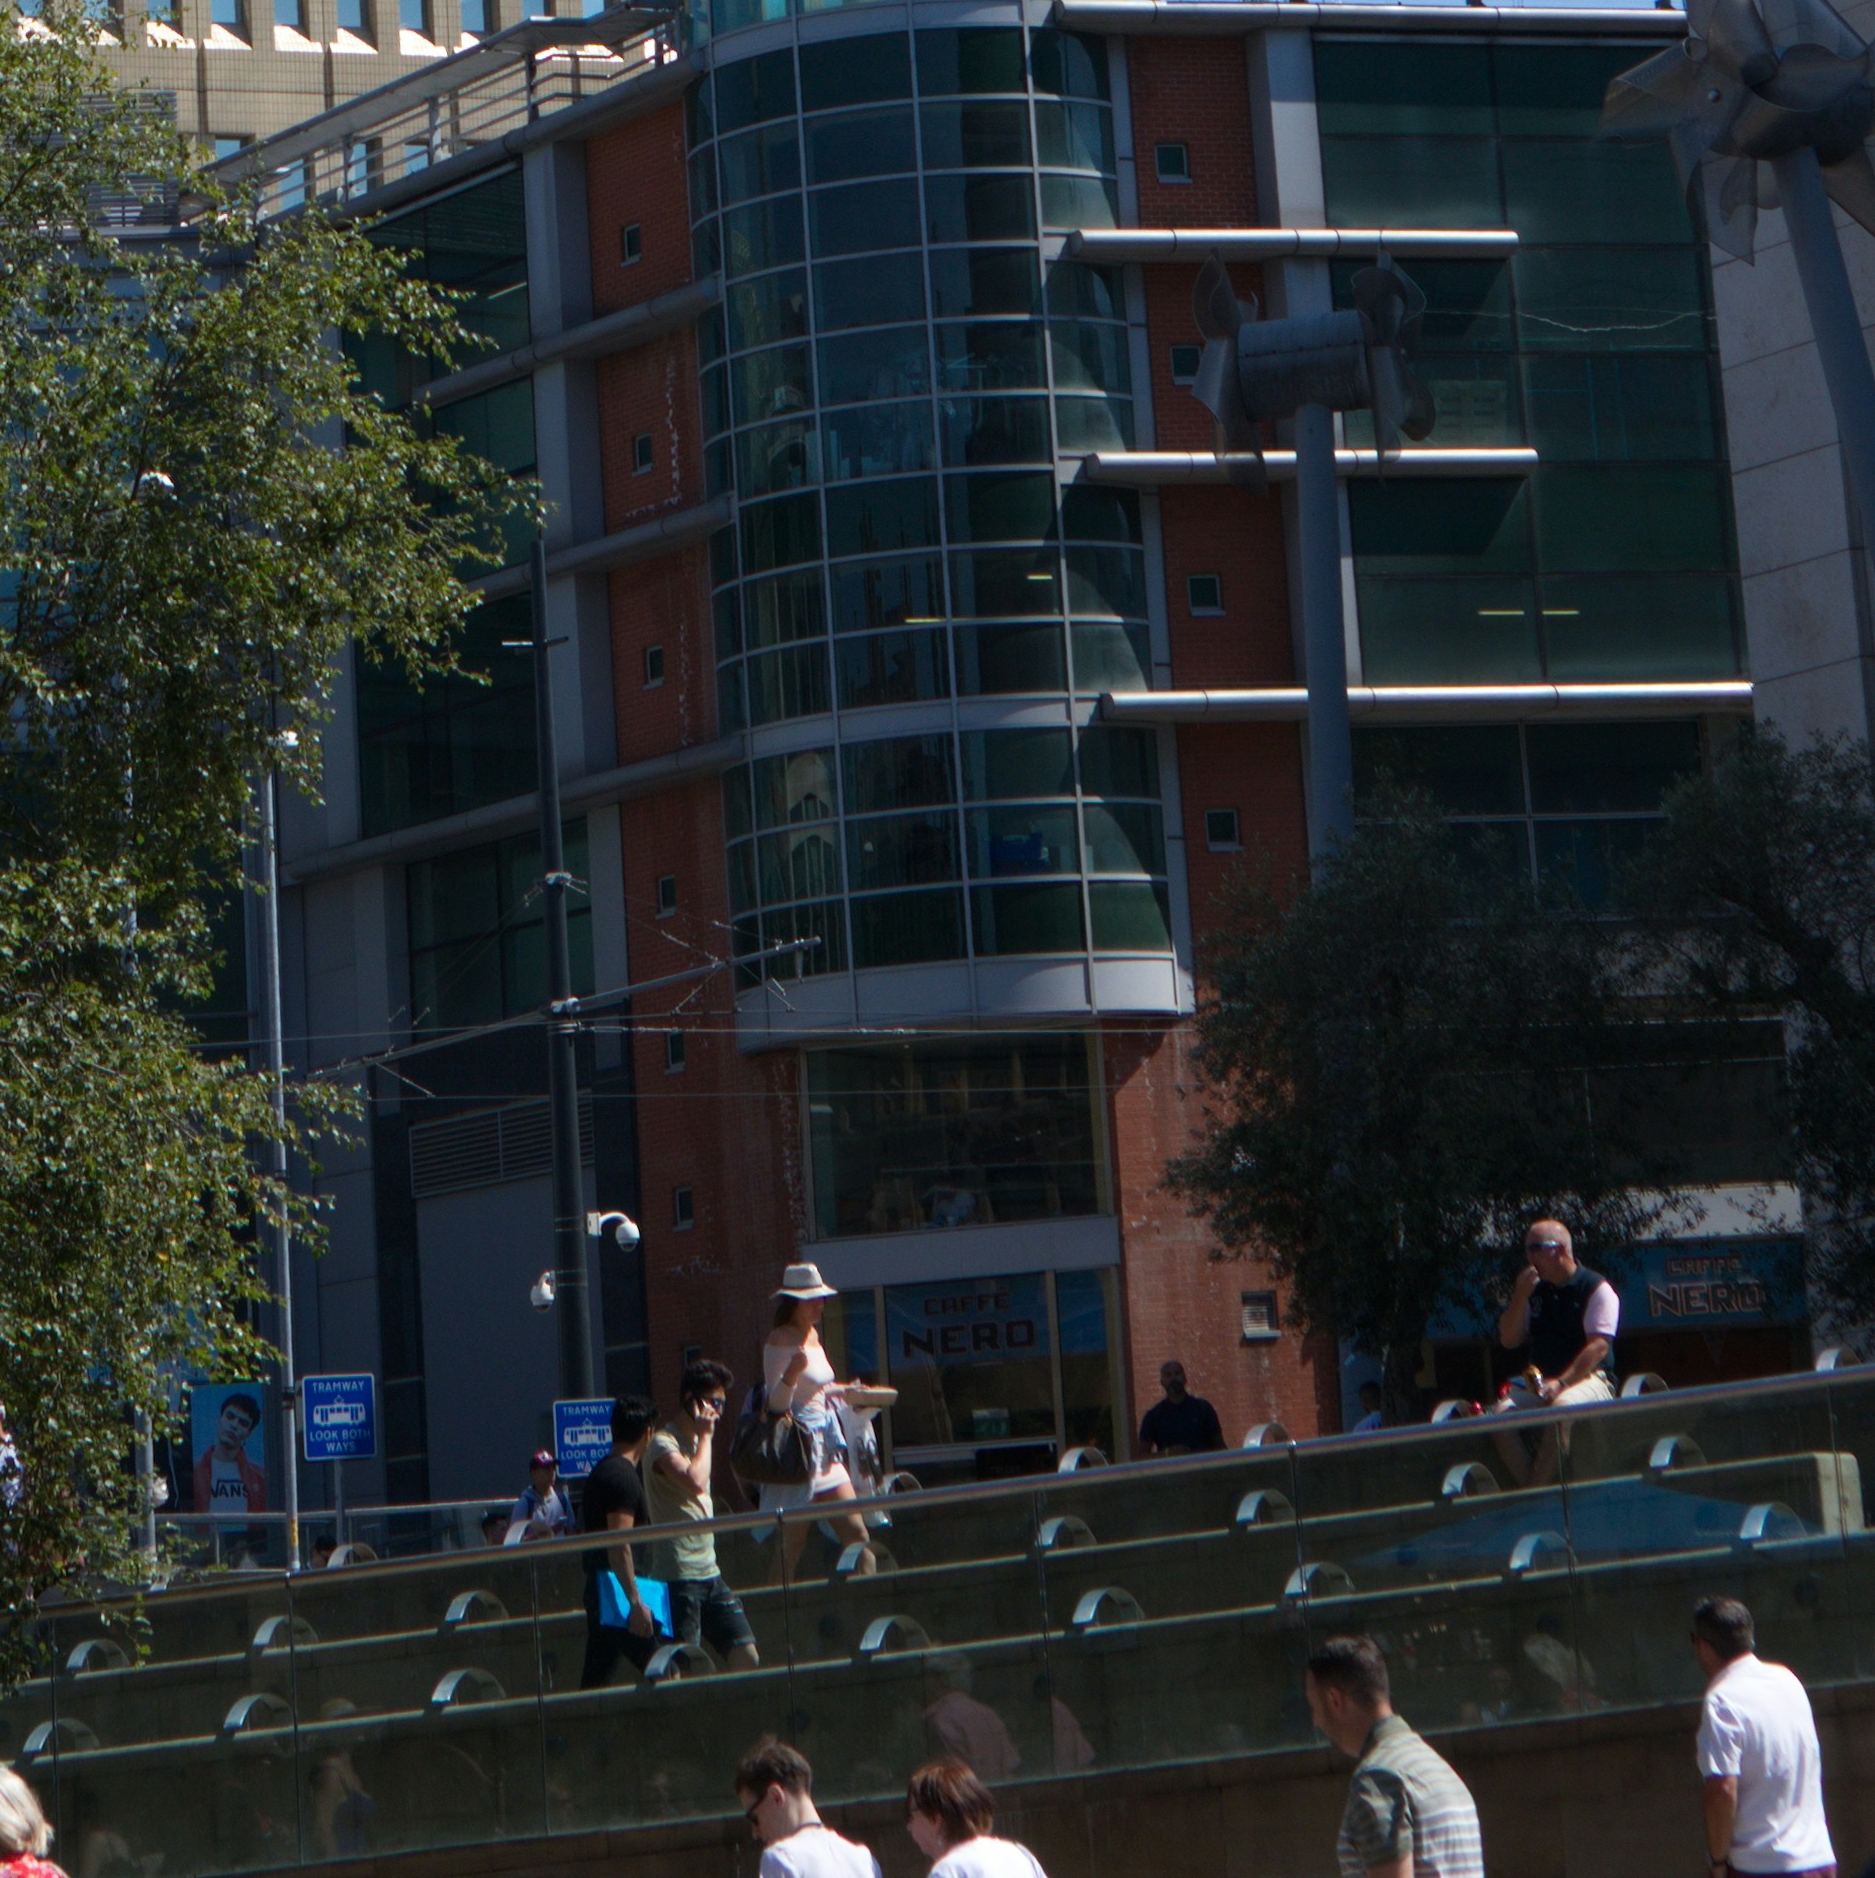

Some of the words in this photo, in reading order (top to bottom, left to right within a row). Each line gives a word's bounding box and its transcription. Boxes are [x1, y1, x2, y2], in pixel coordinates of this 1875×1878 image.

[1648, 1281, 1766, 1317] NERO
[902, 1320, 1036, 1358] NERO
[312, 1380, 365, 1393] TRAMWAY
[562, 1405, 611, 1416] TRAMWAY
[309, 1430, 339, 1442] LOOK
[341, 1429, 371, 1440] BOTH
[326, 1441, 356, 1453] WAYS
[561, 1449, 587, 1460] LOOK
[590, 1448, 611, 1458] BOT
